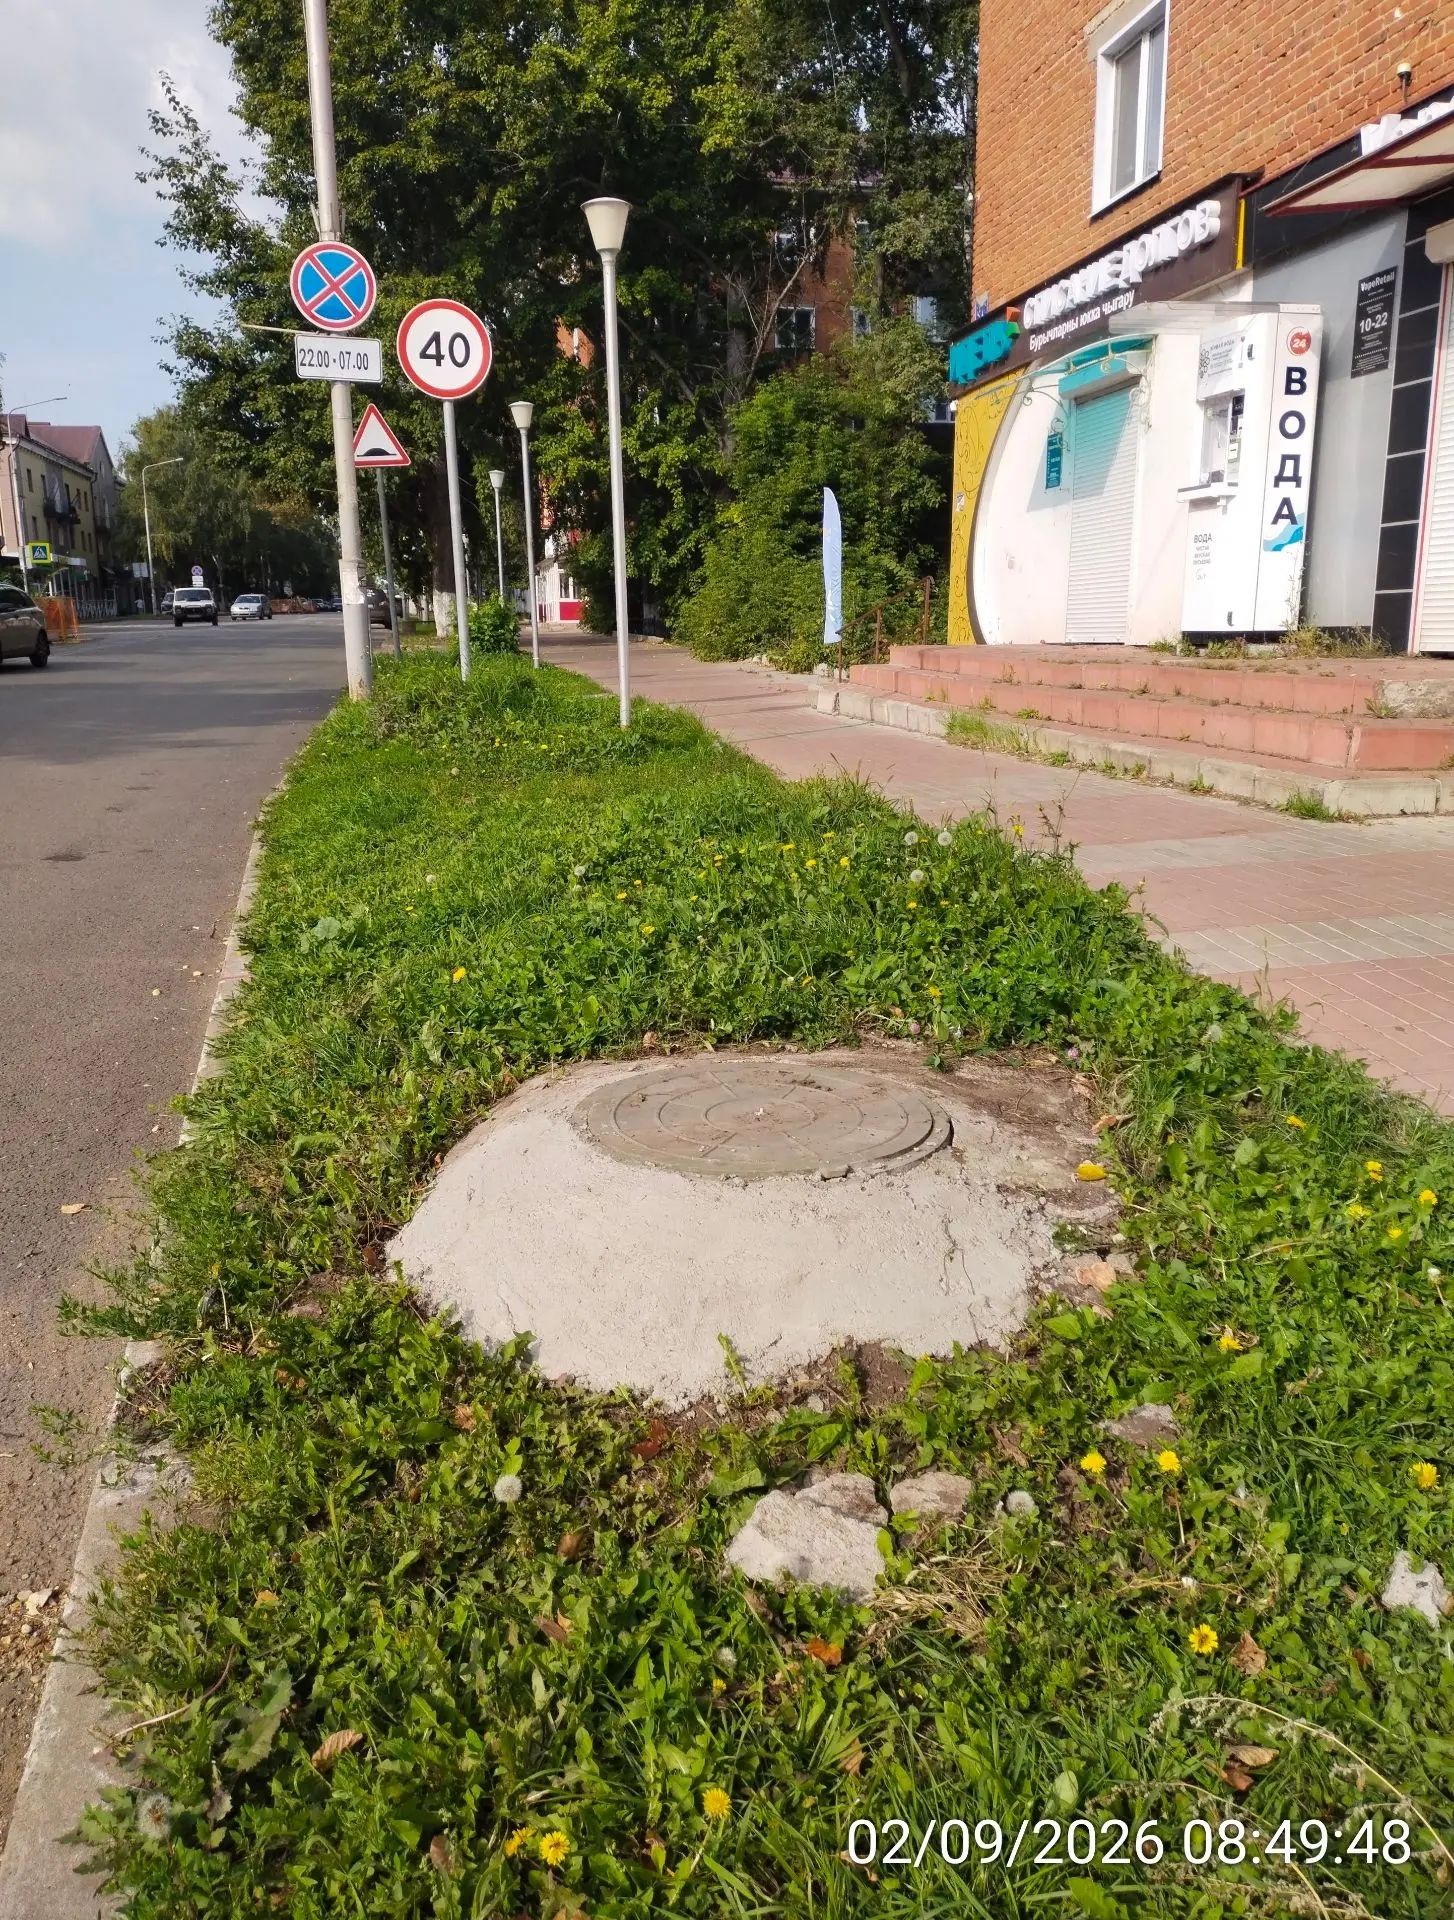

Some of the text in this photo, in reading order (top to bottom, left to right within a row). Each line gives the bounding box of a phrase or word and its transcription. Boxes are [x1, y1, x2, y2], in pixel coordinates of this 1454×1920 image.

[1119, 200, 1221, 288] ДОЛГОВ
[1029, 289, 1135, 351] Бурычларны юкка чыгару
[1360, 311, 1388, 333] 10-22
[419, 331, 471, 368] 40
[1292, 338, 1307, 348] 24
[299, 348, 330, 368] 22.00
[339, 351, 369, 371] 07.00
[1271, 366, 1307, 525] ВОДА
[1193, 533, 1213, 544] ВОДА
